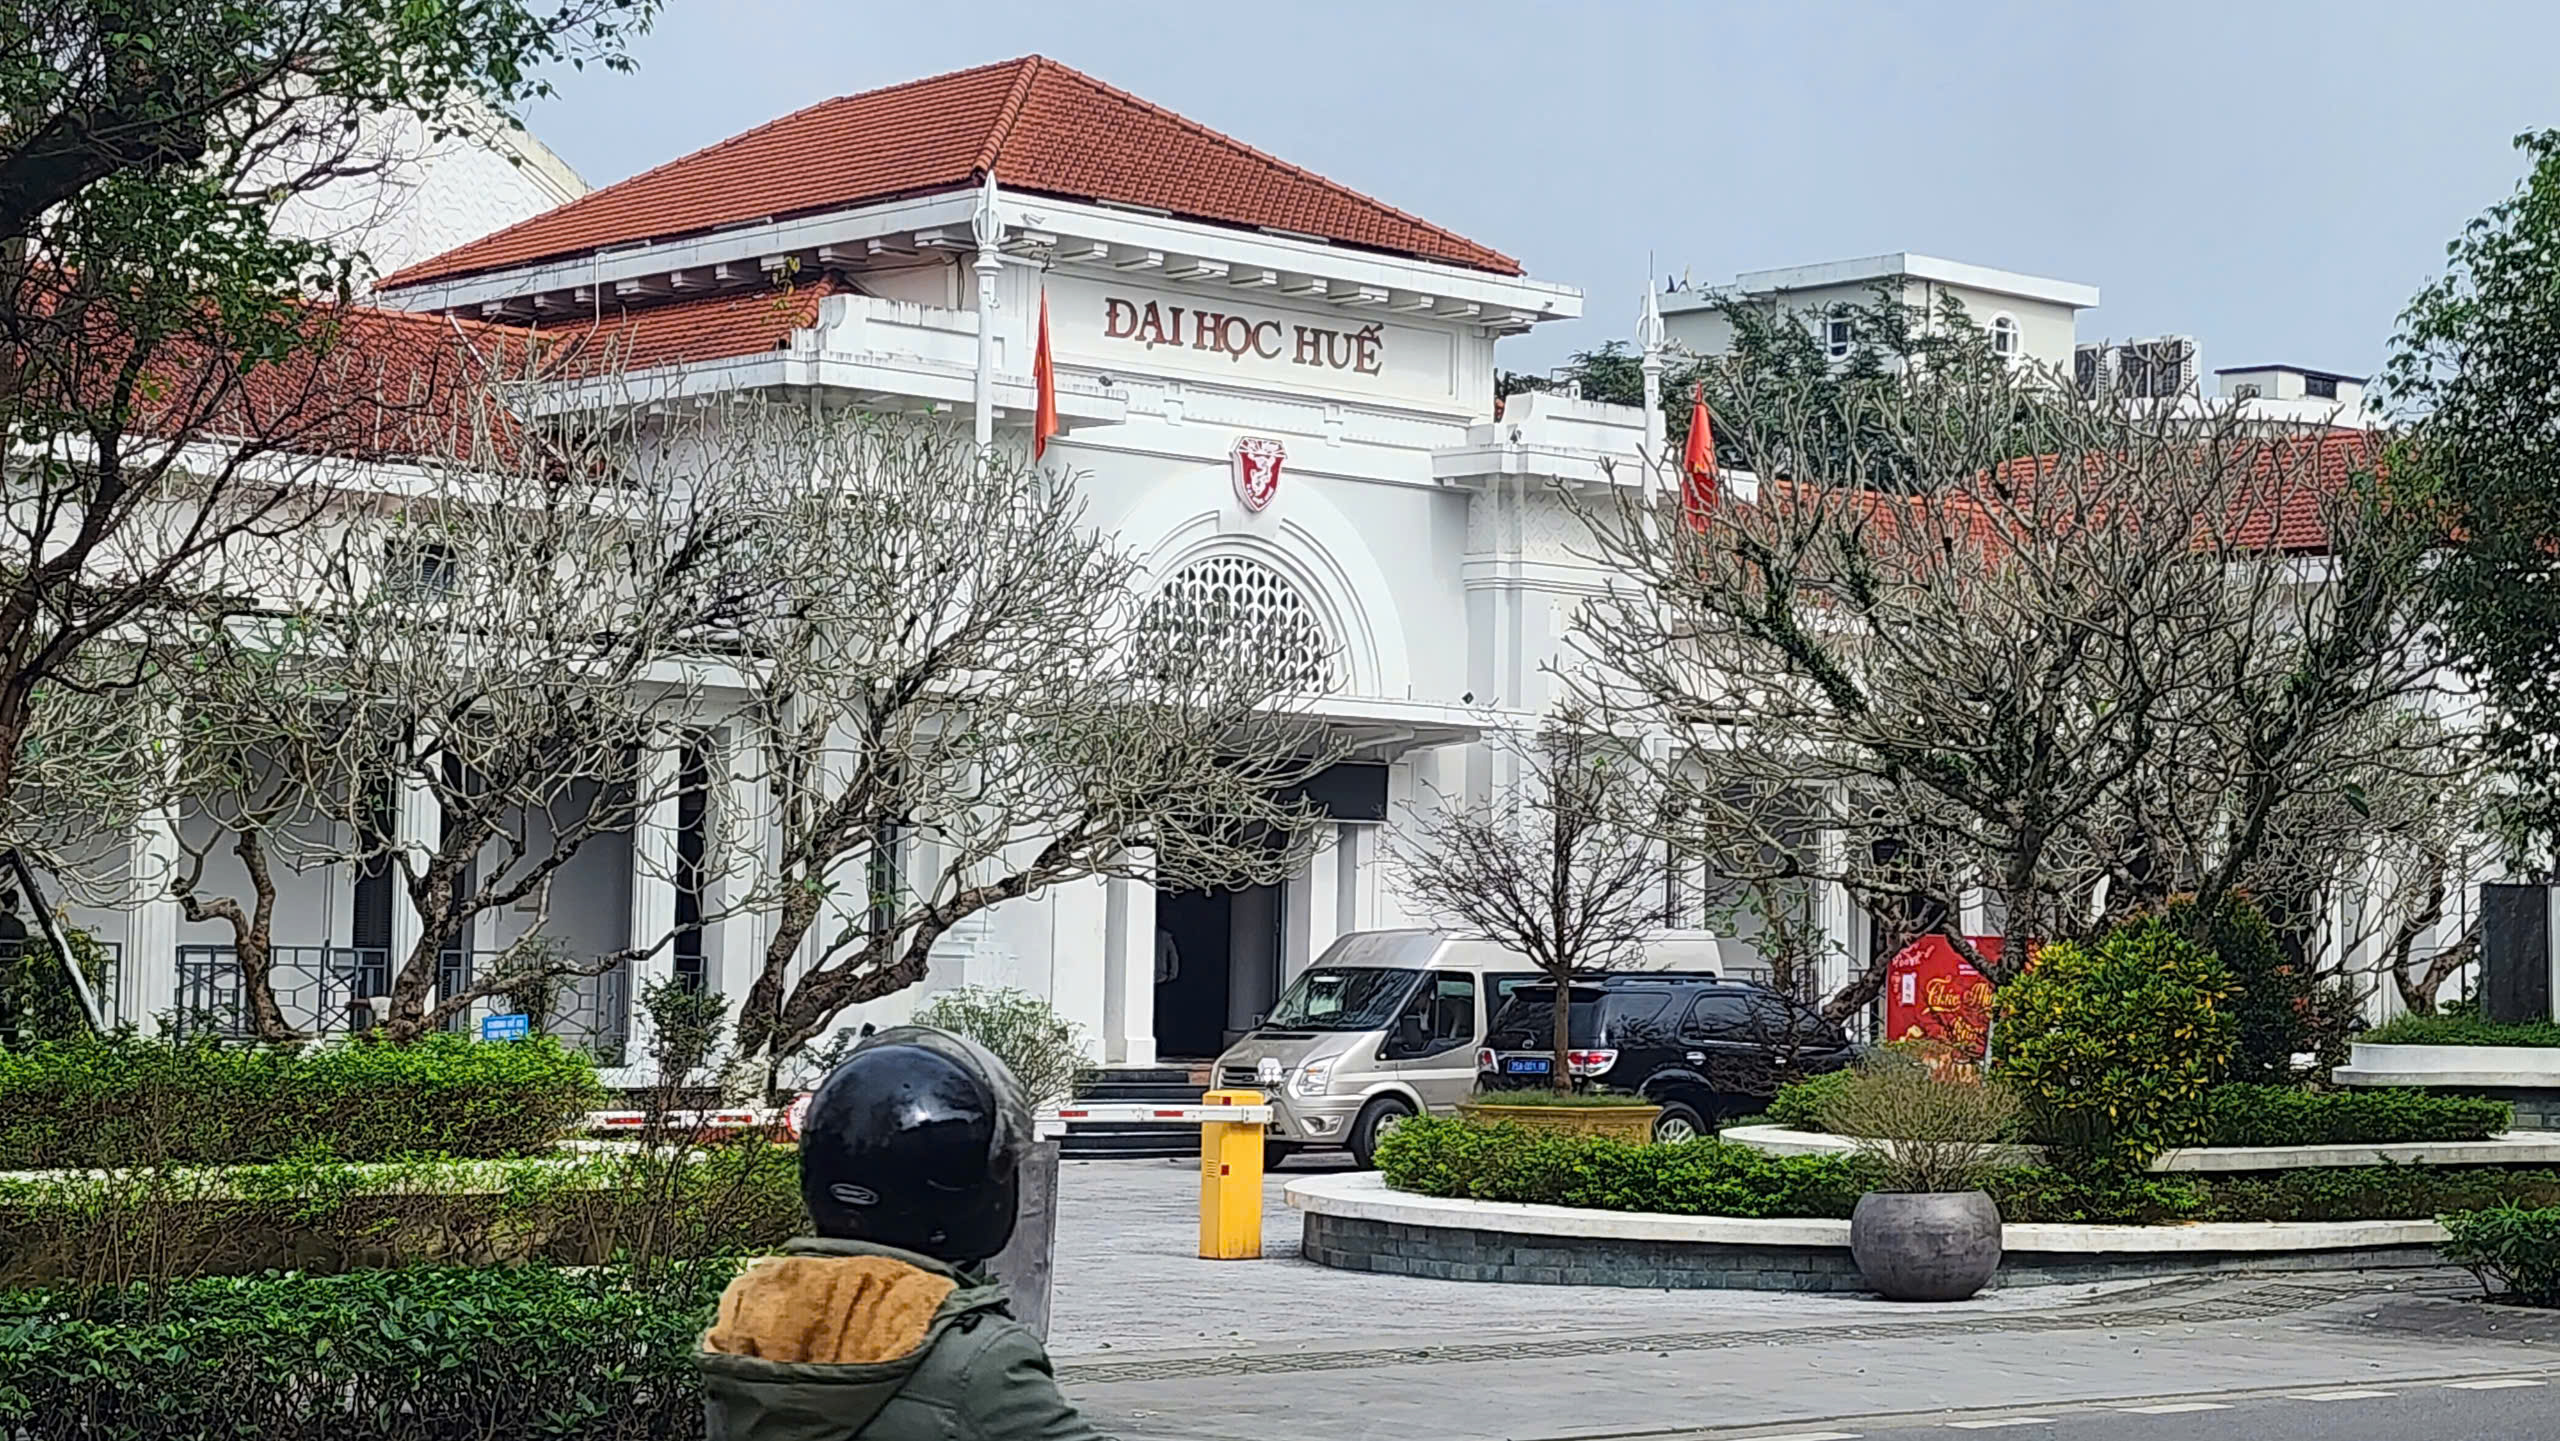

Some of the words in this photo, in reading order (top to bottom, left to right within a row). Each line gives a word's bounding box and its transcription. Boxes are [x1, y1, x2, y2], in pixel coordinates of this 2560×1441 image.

[1104, 297, 1184, 351] ĐẠI
[1193, 310, 1282, 363] HỌC
[1292, 322, 1384, 376] HUẾ
